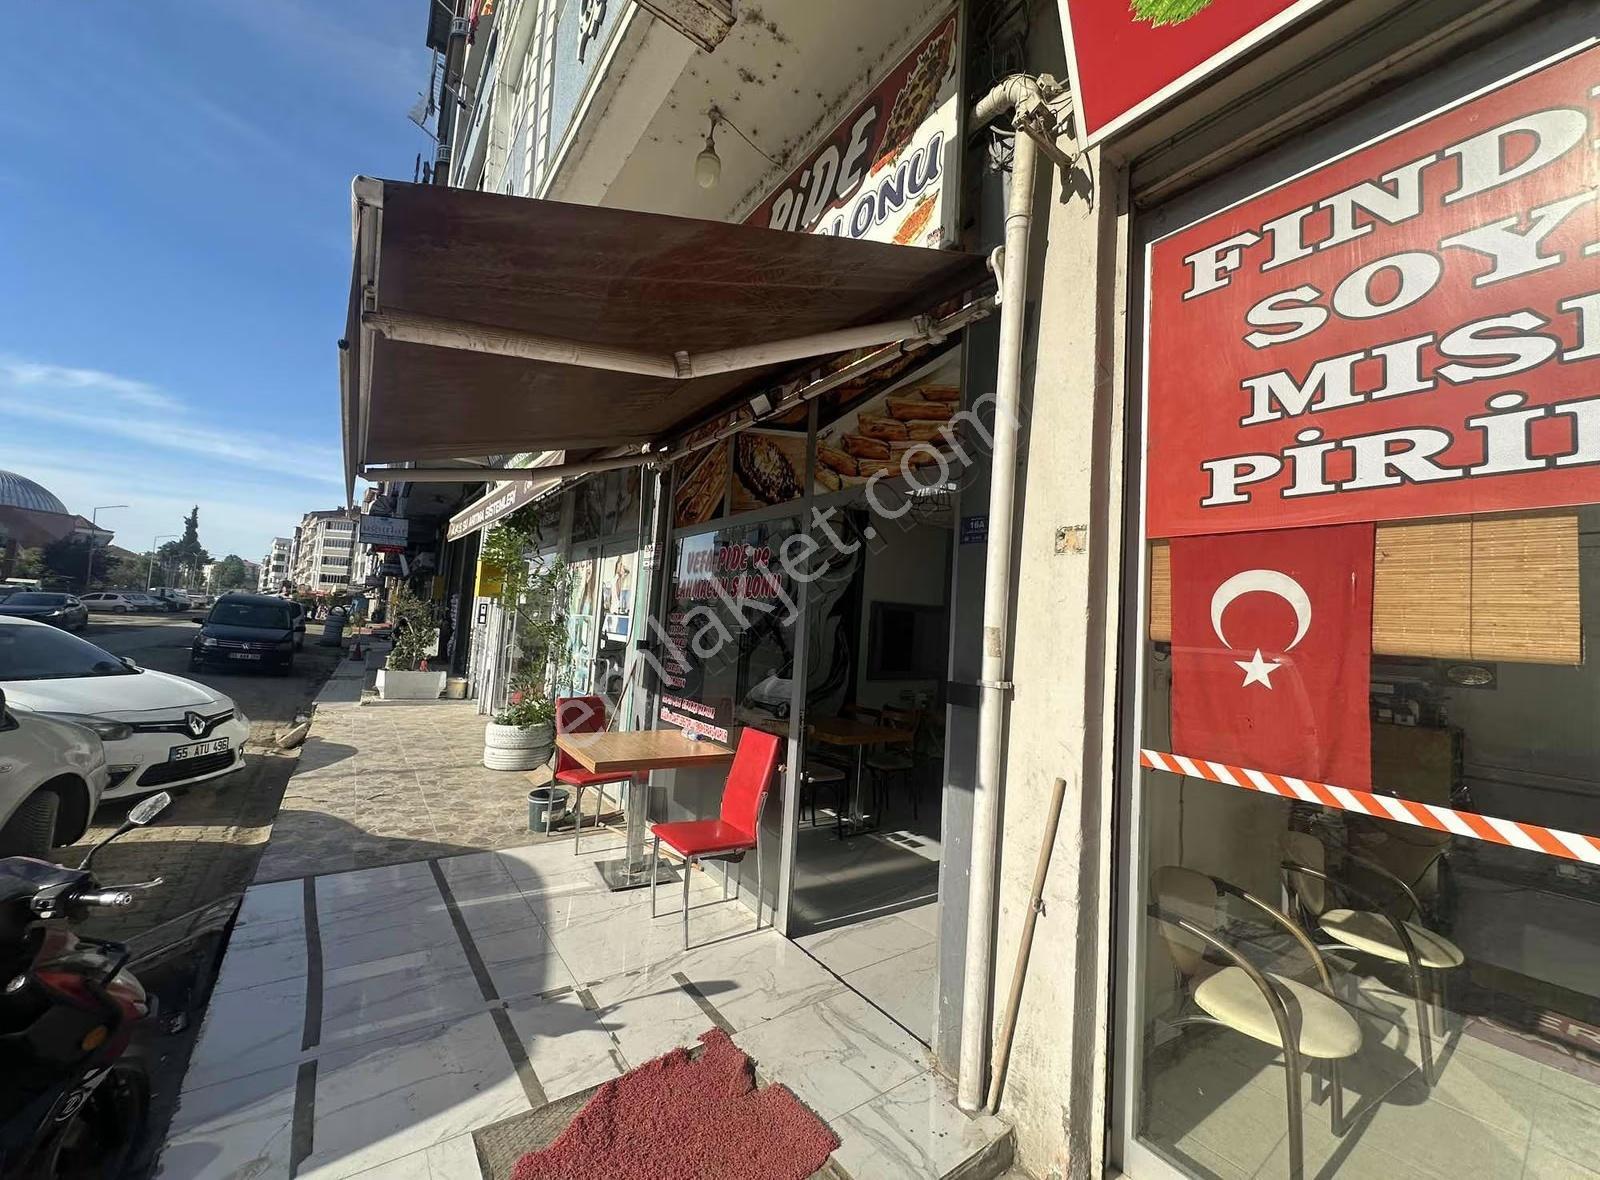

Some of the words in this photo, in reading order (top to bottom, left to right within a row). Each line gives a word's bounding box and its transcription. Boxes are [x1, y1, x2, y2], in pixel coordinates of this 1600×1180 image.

[1183, 85, 1600, 300] FIND
[1243, 190, 1600, 349] SOY
[175, 747, 188, 760] 55
[194, 742, 210, 757] ATU
